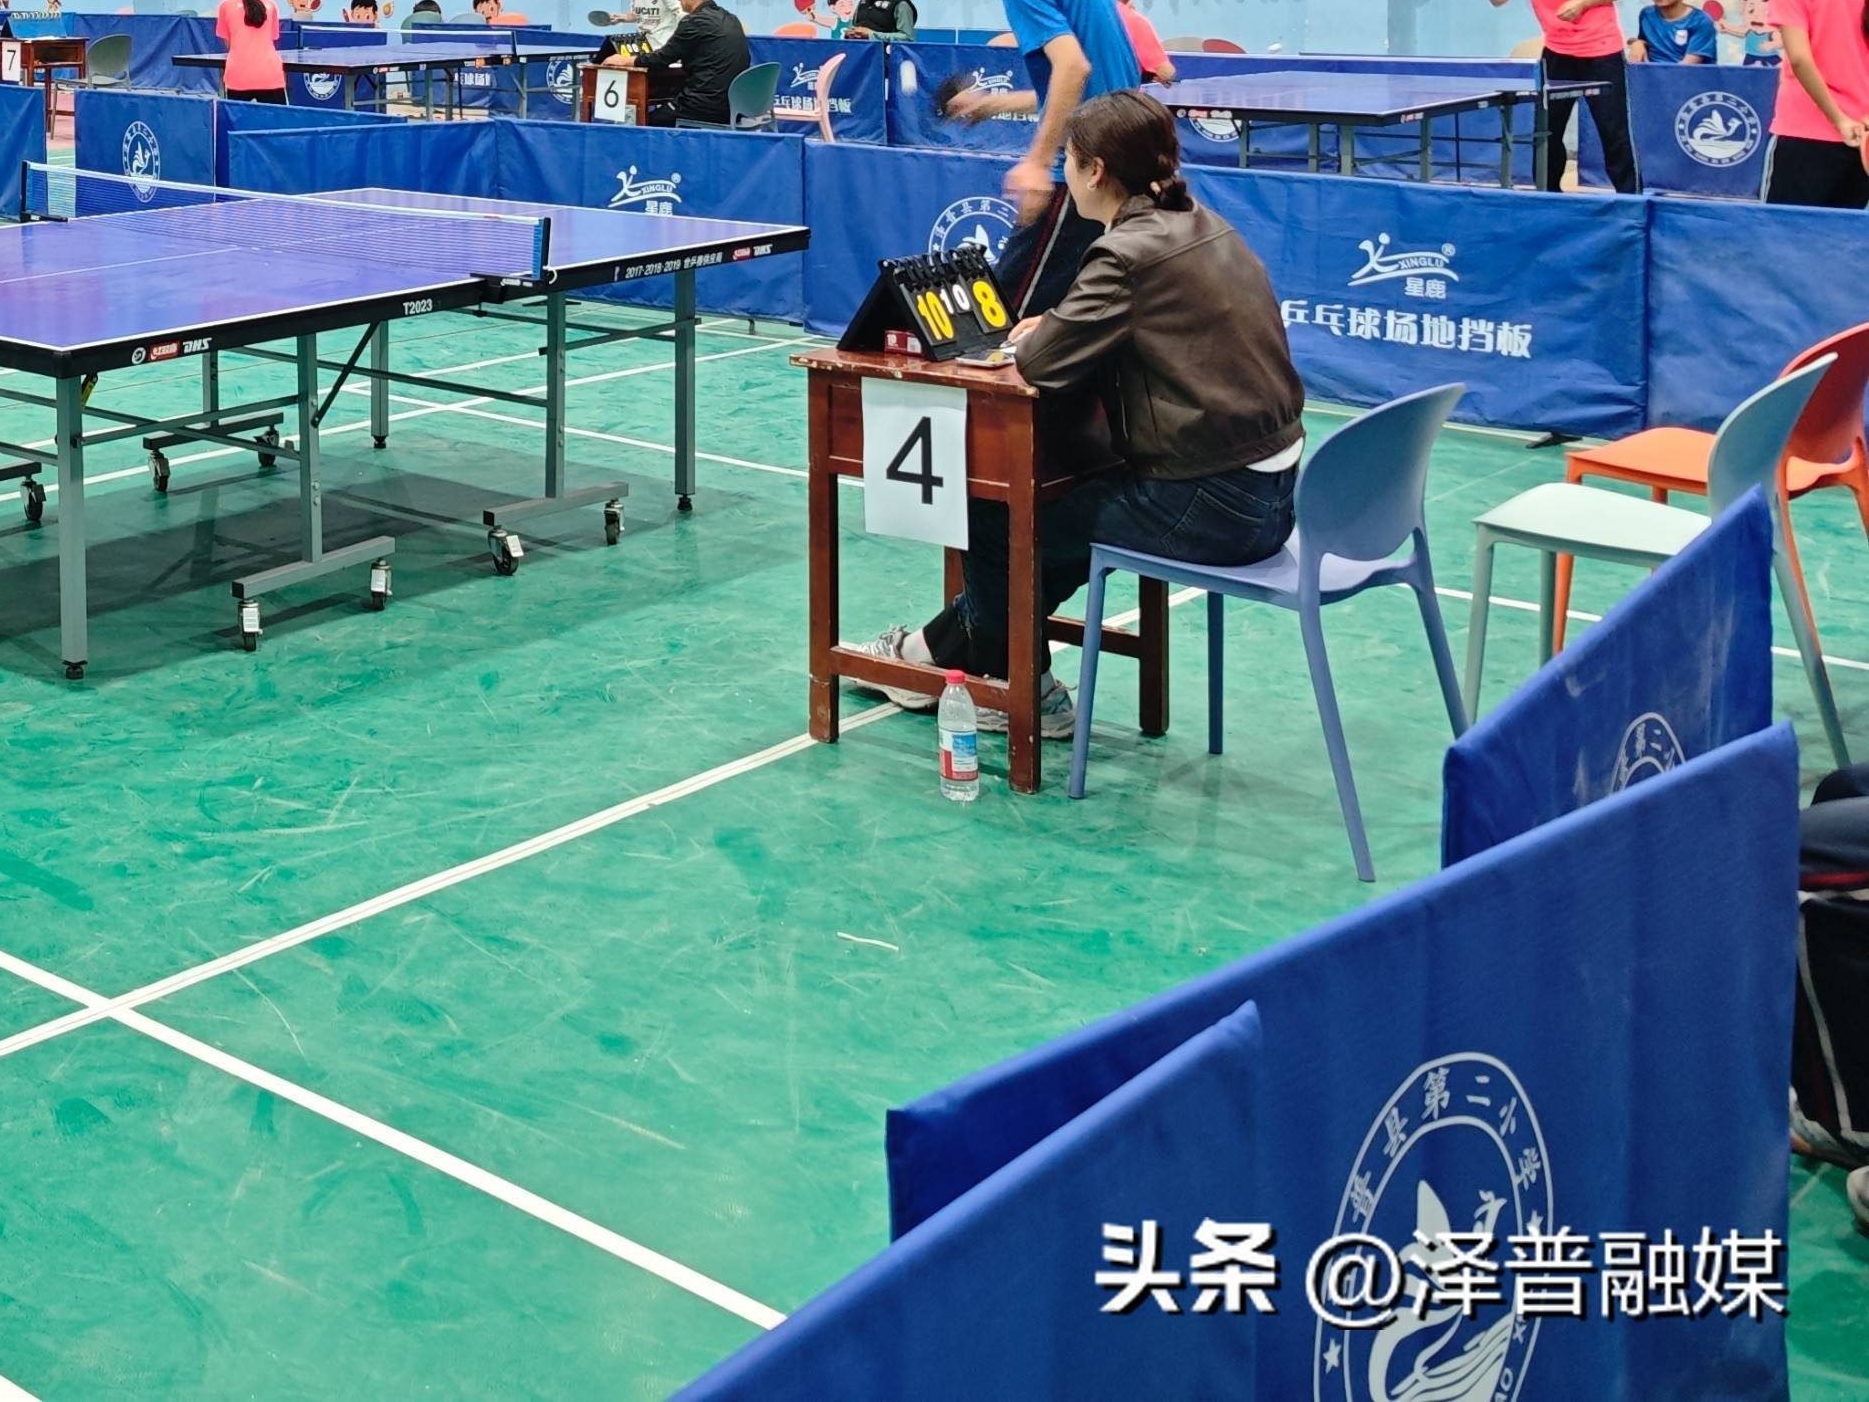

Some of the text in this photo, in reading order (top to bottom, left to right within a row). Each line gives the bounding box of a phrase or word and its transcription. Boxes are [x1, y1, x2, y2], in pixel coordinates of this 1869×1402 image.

[635, 7, 660, 15] UCATI
[7, 50, 16, 70] 7
[604, 80, 620, 108] 6
[1398, 257, 1444, 270] XINGLU
[1404, 277, 1447, 299] 星鹿
[403, 298, 433, 315] T2023
[917, 291, 955, 340] 10
[973, 281, 1007, 327] 8
[1281, 300, 1532, 359] 乒乓球场地挡板
[183, 337, 212, 353] DHS
[886, 416, 944, 505] 4
